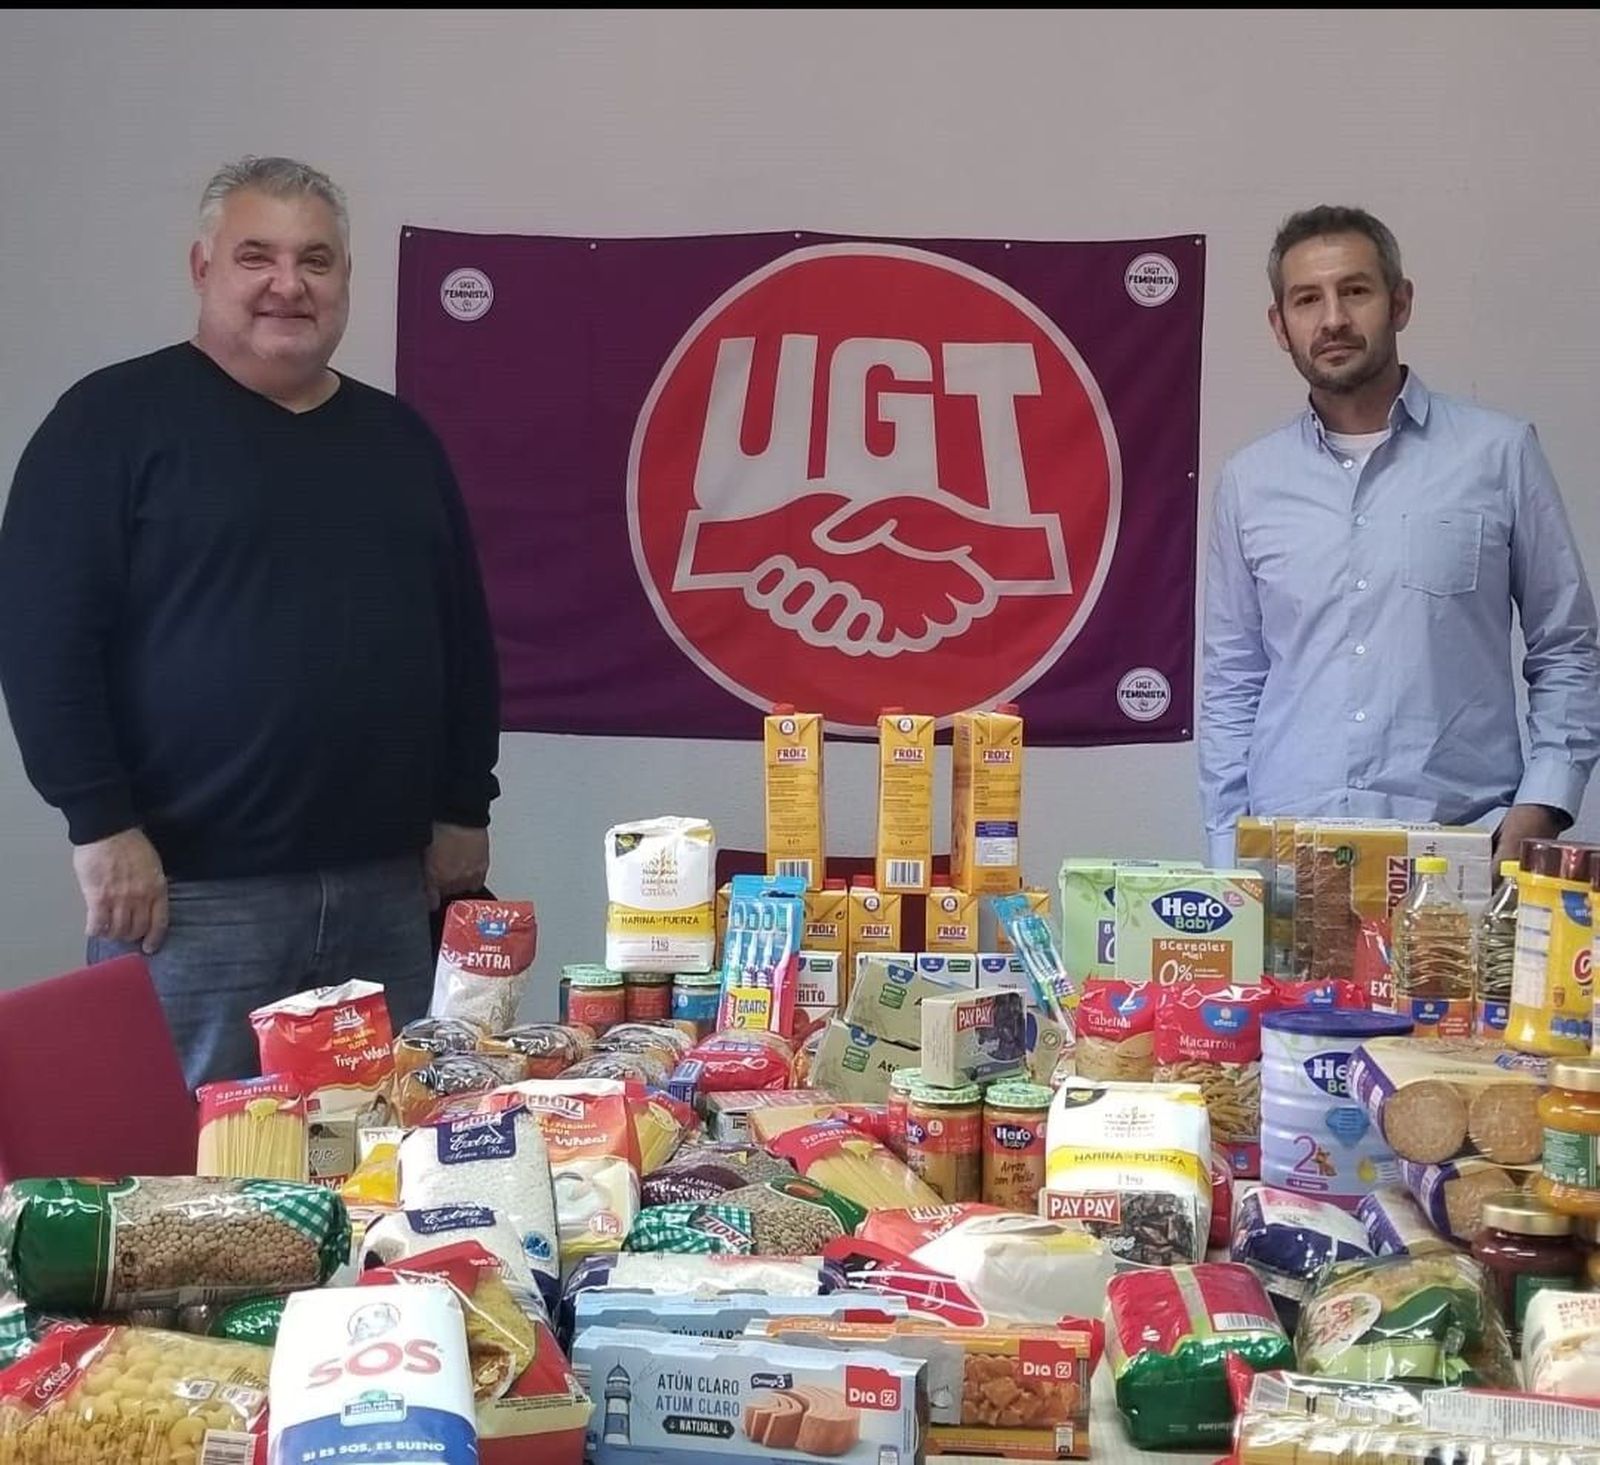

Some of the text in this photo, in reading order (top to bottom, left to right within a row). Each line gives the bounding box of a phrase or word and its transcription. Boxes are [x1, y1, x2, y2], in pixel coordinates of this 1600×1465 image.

[1144, 267, 1160, 275] UGT
[1129, 275, 1174, 285] FEMINISTA
[444, 289, 490, 299] FEMINISTA
[692, 334, 1042, 523] UGT
[1136, 681, 1152, 689] UGT
[1121, 690, 1167, 699] FEMINISTA
[777, 748, 807, 760] FROIZ
[894, 748, 923, 760] FROIZ
[983, 750, 1012, 761] FROIZ
[1161, 897, 1224, 917] Hero
[621, 915, 700, 925] HARINA FUERZA
[1175, 917, 1215, 932] Baby
[807, 924, 836, 935] FROIZ
[861, 925, 890, 936] FROIZ
[937, 926, 967, 937] FROIZ
[467, 951, 512, 970] EXTRA
[1313, 1059, 1348, 1079] He
[555, 1133, 608, 1147] Wheat
[996, 1126, 1032, 1141] Hero
[1074, 1151, 1124, 1162] HARINA
[1293, 1135, 1317, 1173] 2
[1050, 1198, 1115, 1218] PAY PAY
[305, 1339, 442, 1389] SOS
[657, 1370, 740, 1396] ATÚN CLARO
[655, 1394, 741, 1417] ATUM CLARO
[678, 1417, 720, 1435] NATURAL
[301, 1451, 316, 1462] SI
[319, 1447, 335, 1459] ES
[375, 1441, 393, 1451] ES
[395, 1440, 446, 1452] BUENO
